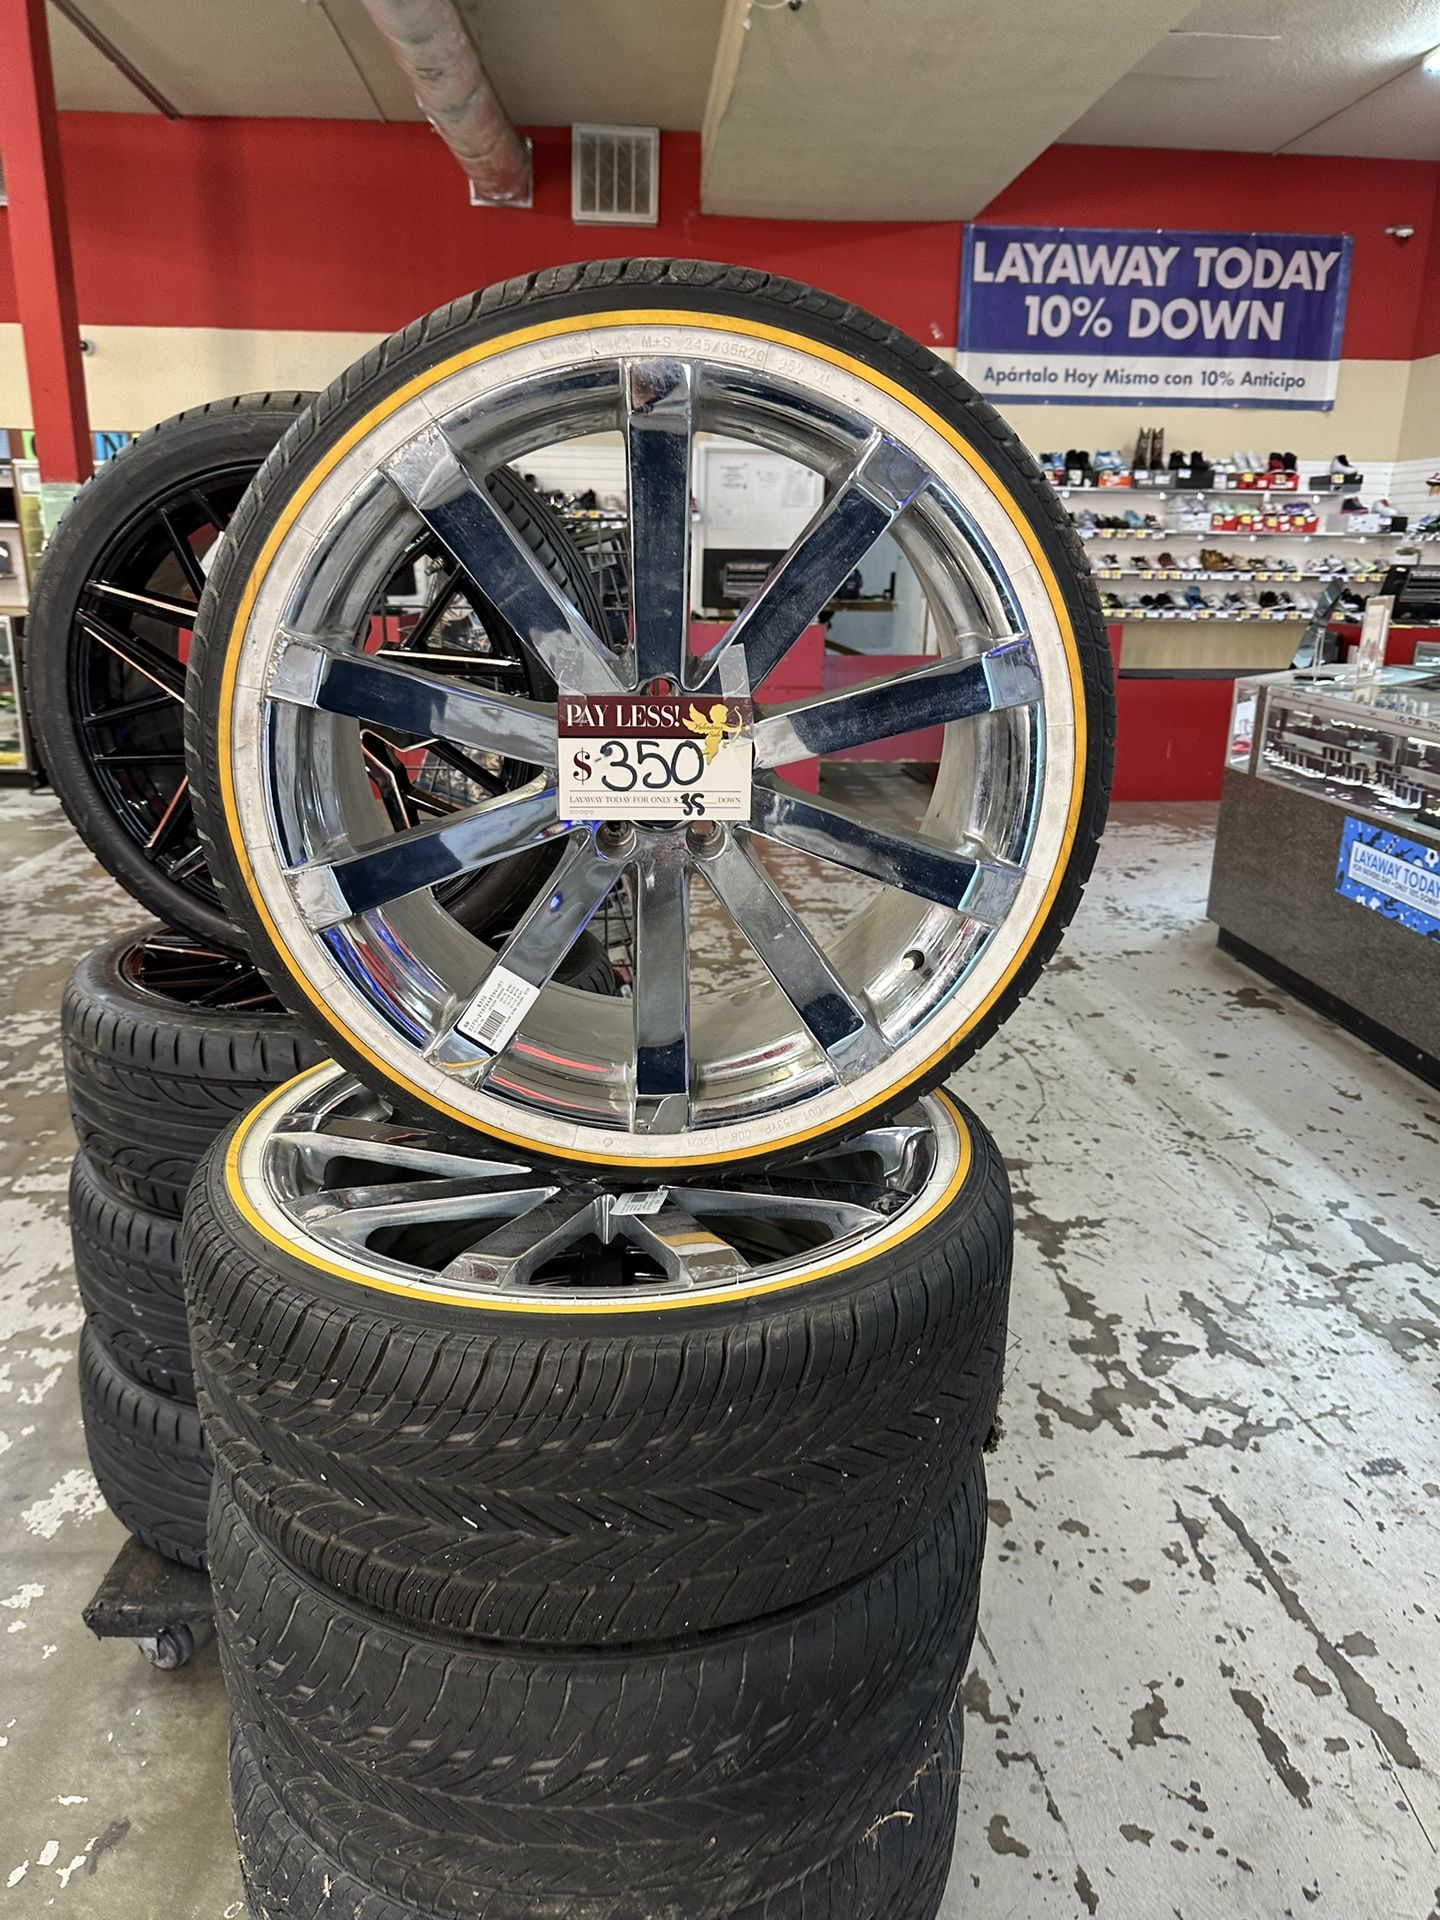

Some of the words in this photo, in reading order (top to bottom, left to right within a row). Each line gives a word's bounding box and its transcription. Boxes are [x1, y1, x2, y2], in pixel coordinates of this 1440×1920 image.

[973, 241, 1180, 287] LAYAWAY
[1193, 246, 1341, 291] TODAY
[1024, 294, 1112, 338] 10%
[1128, 298, 1284, 341] DOWN
[984, 366, 1058, 385] Apártalo
[1064, 369, 1098, 388] Hoy
[1103, 370, 1159, 386] Mismo
[1165, 374, 1193, 386] con
[1201, 371, 1235, 387] 10%
[1240, 371, 1306, 390] Anticipo
[566, 704, 608, 727] PAY
[616, 704, 680, 728] LESS!
[600, 740, 705, 792] 350
[569, 795, 602, 804] LAYAWAY
[606, 795, 631, 804] TODAY
[633, 795, 649, 804] FOR
[651, 795, 671, 804] ONLY
[718, 795, 741, 804] DOWN
[1354, 848, 1402, 880] LAYAWAY
